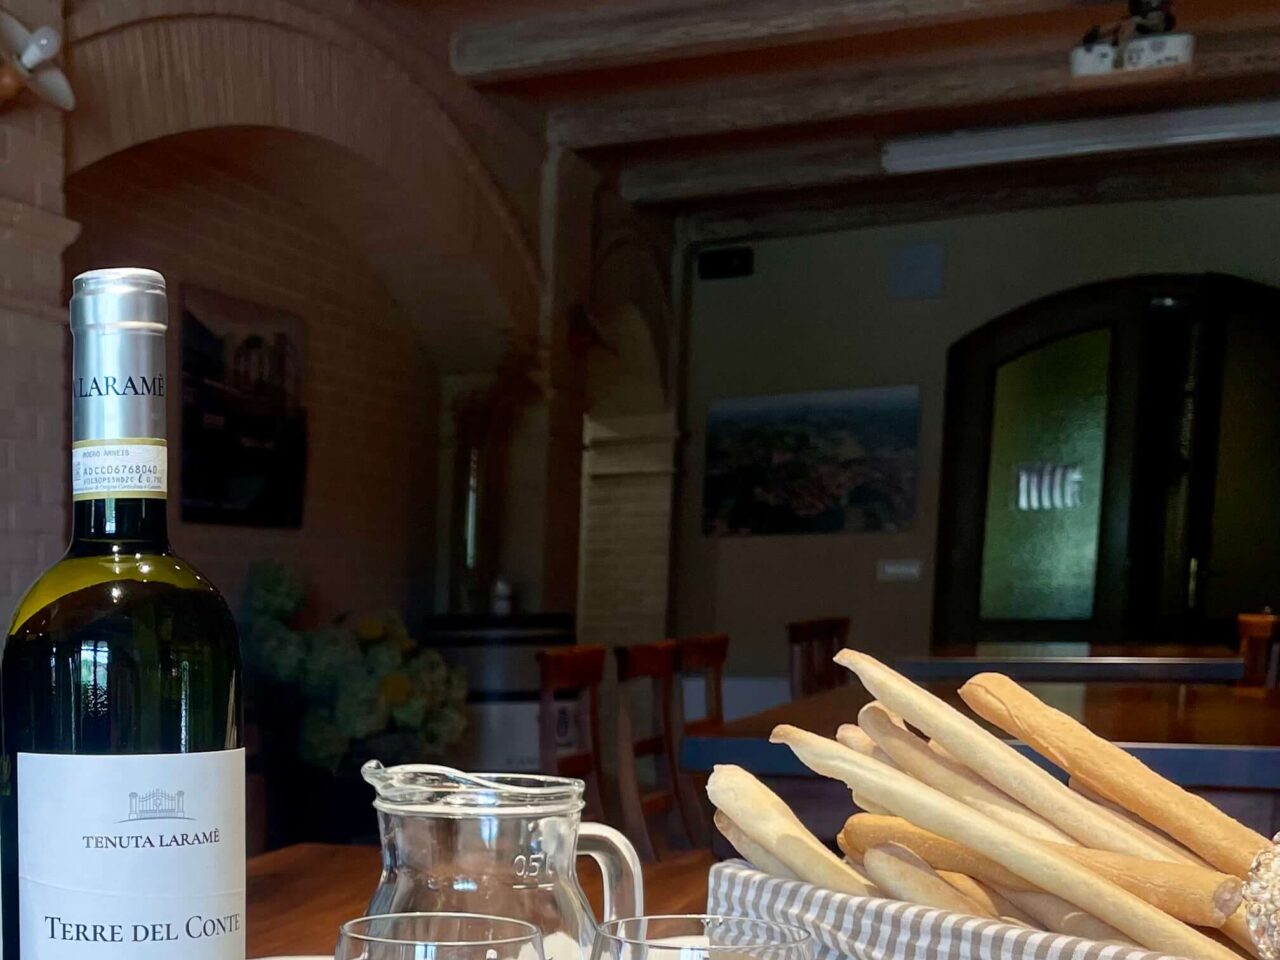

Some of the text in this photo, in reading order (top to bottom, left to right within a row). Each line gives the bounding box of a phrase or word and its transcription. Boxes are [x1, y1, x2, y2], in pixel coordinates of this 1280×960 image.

[78, 374, 165, 398] LARAMÈ
[82, 828, 220, 849] TENUTA LARAMÈ
[44, 913, 241, 942] TERRE DEL CONTE
